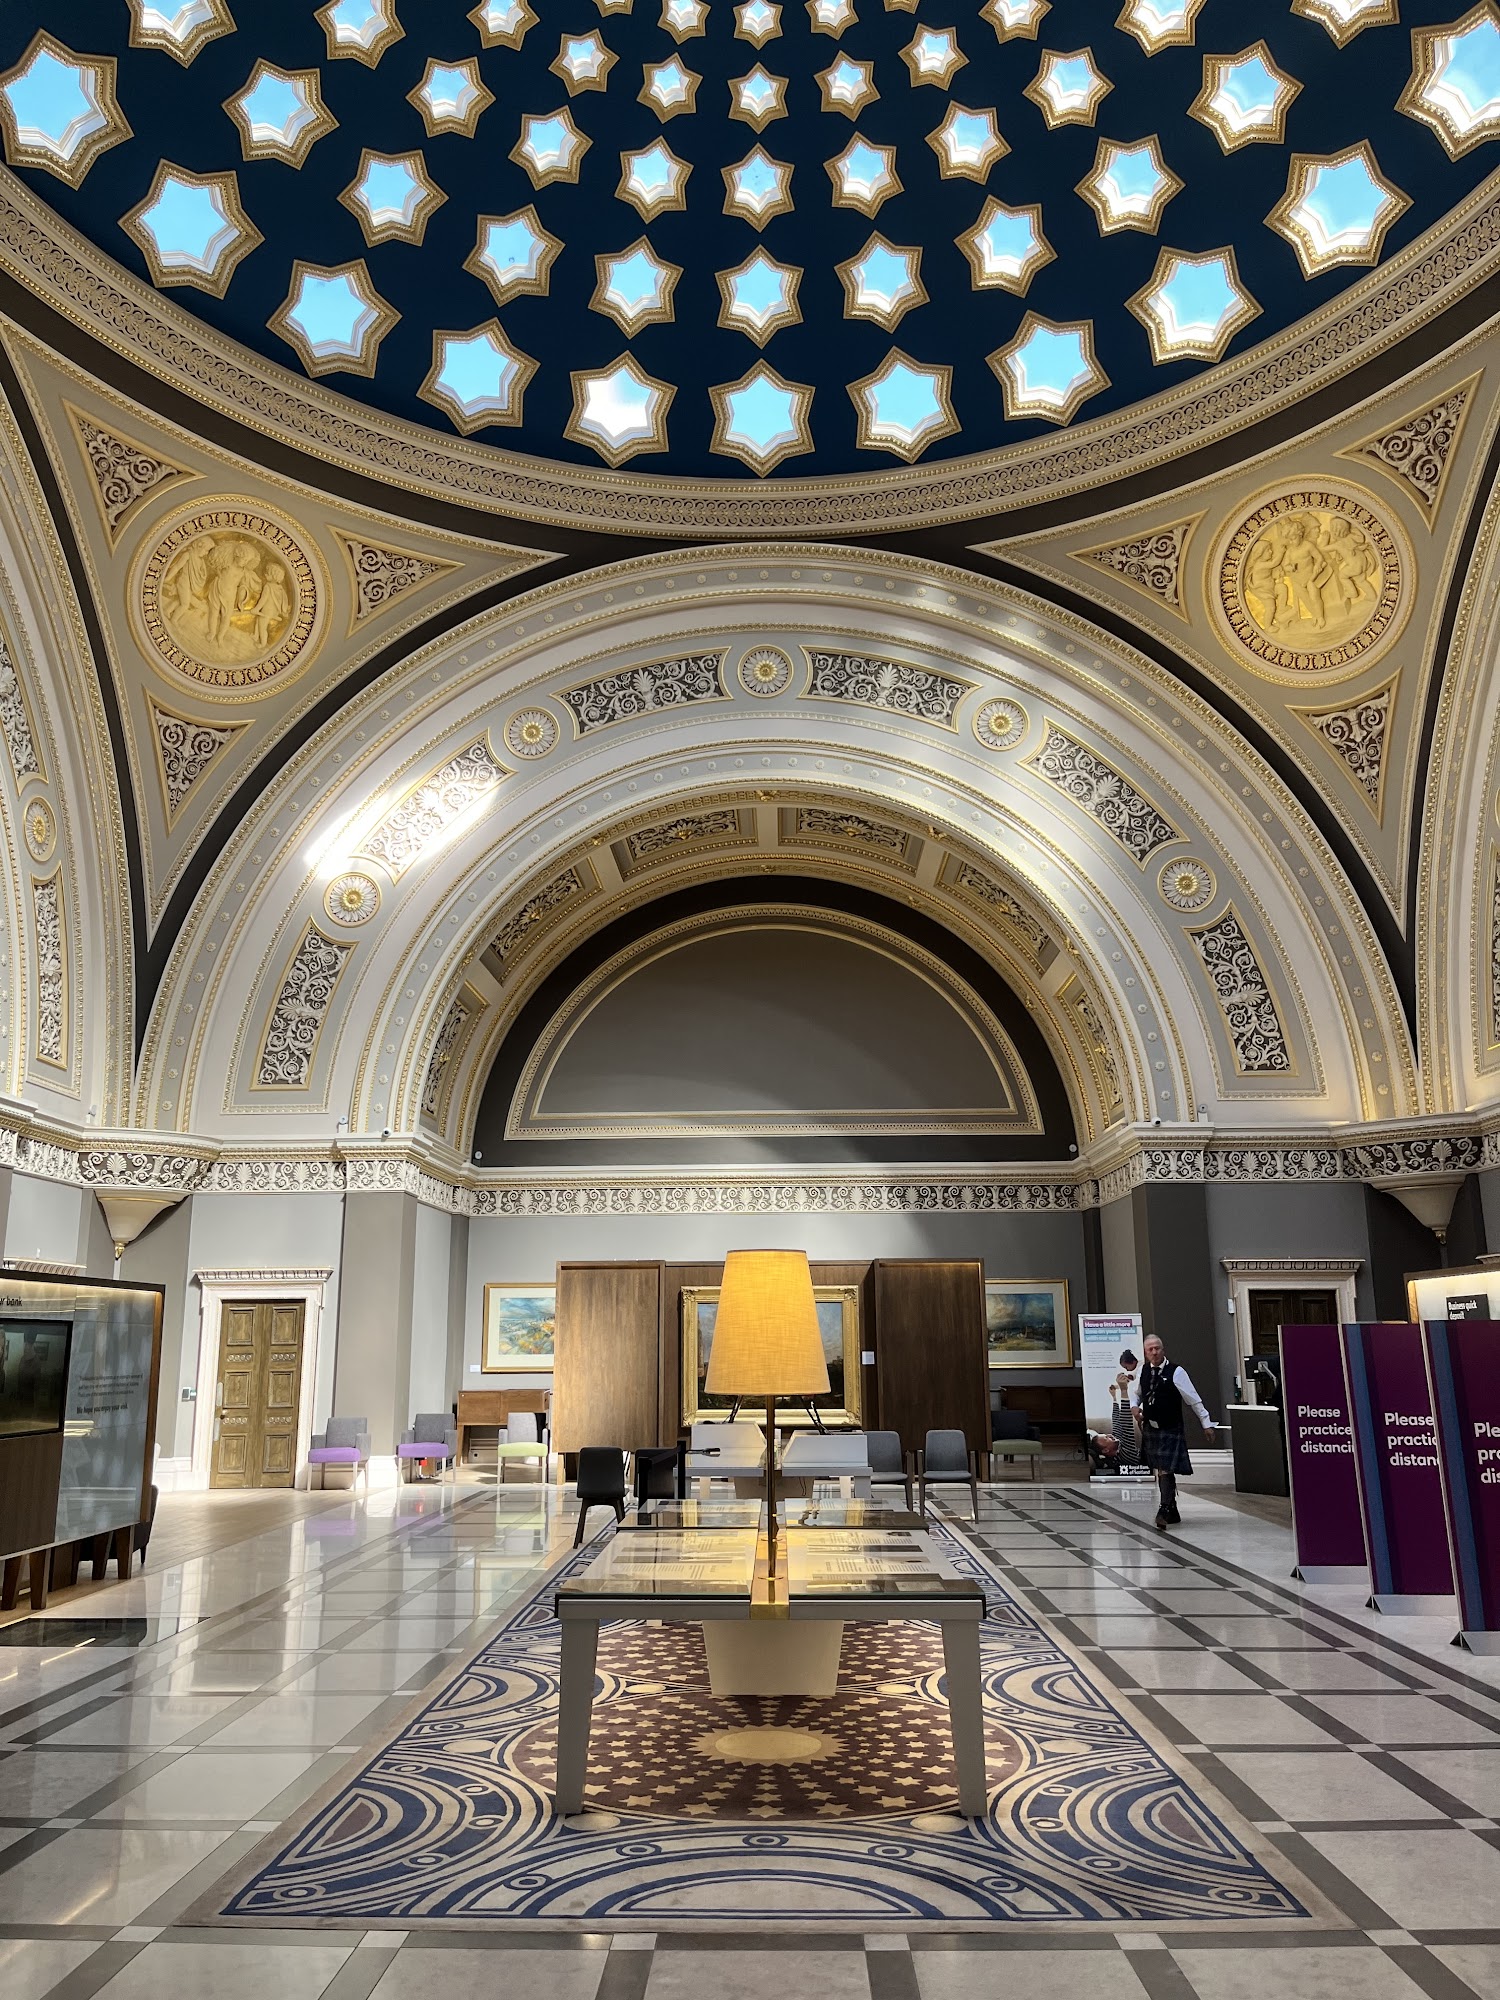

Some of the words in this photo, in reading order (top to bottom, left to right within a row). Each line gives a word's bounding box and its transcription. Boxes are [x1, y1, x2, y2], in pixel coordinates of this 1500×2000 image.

[6, 1295, 22, 1306] bank
[1448, 1301, 1466, 1310] Business
[1466, 1300, 1477, 1311] quick
[1297, 1405, 1341, 1418] Please
[1384, 1412, 1434, 1426] Please
[1299, 1423, 1352, 1439] practice
[1473, 1422, 1500, 1438] Ple
